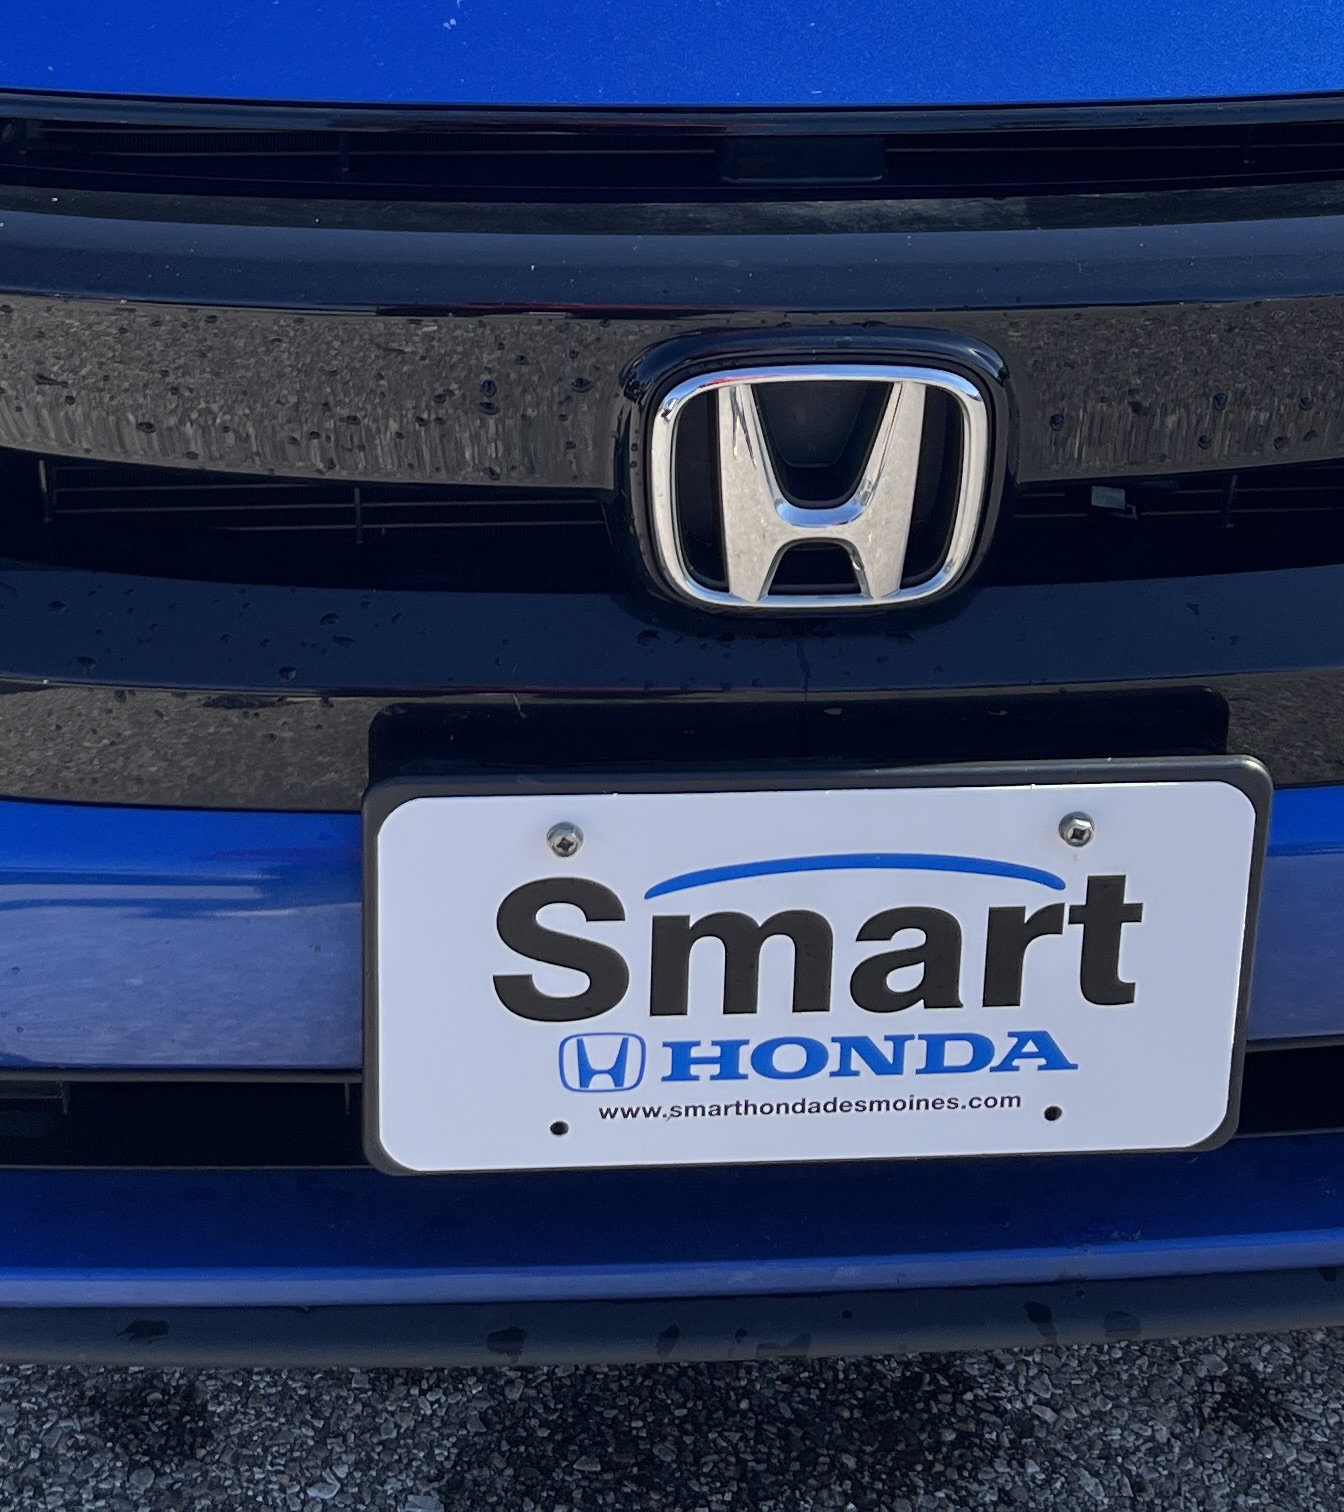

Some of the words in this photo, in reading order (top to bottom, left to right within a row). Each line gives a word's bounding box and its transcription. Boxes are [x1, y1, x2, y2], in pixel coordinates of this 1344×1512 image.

[492, 874, 1144, 1023] Smart
[661, 1031, 1078, 1082] HONDA
[598, 1094, 1022, 1119] www.smarthondadesmoines.com
